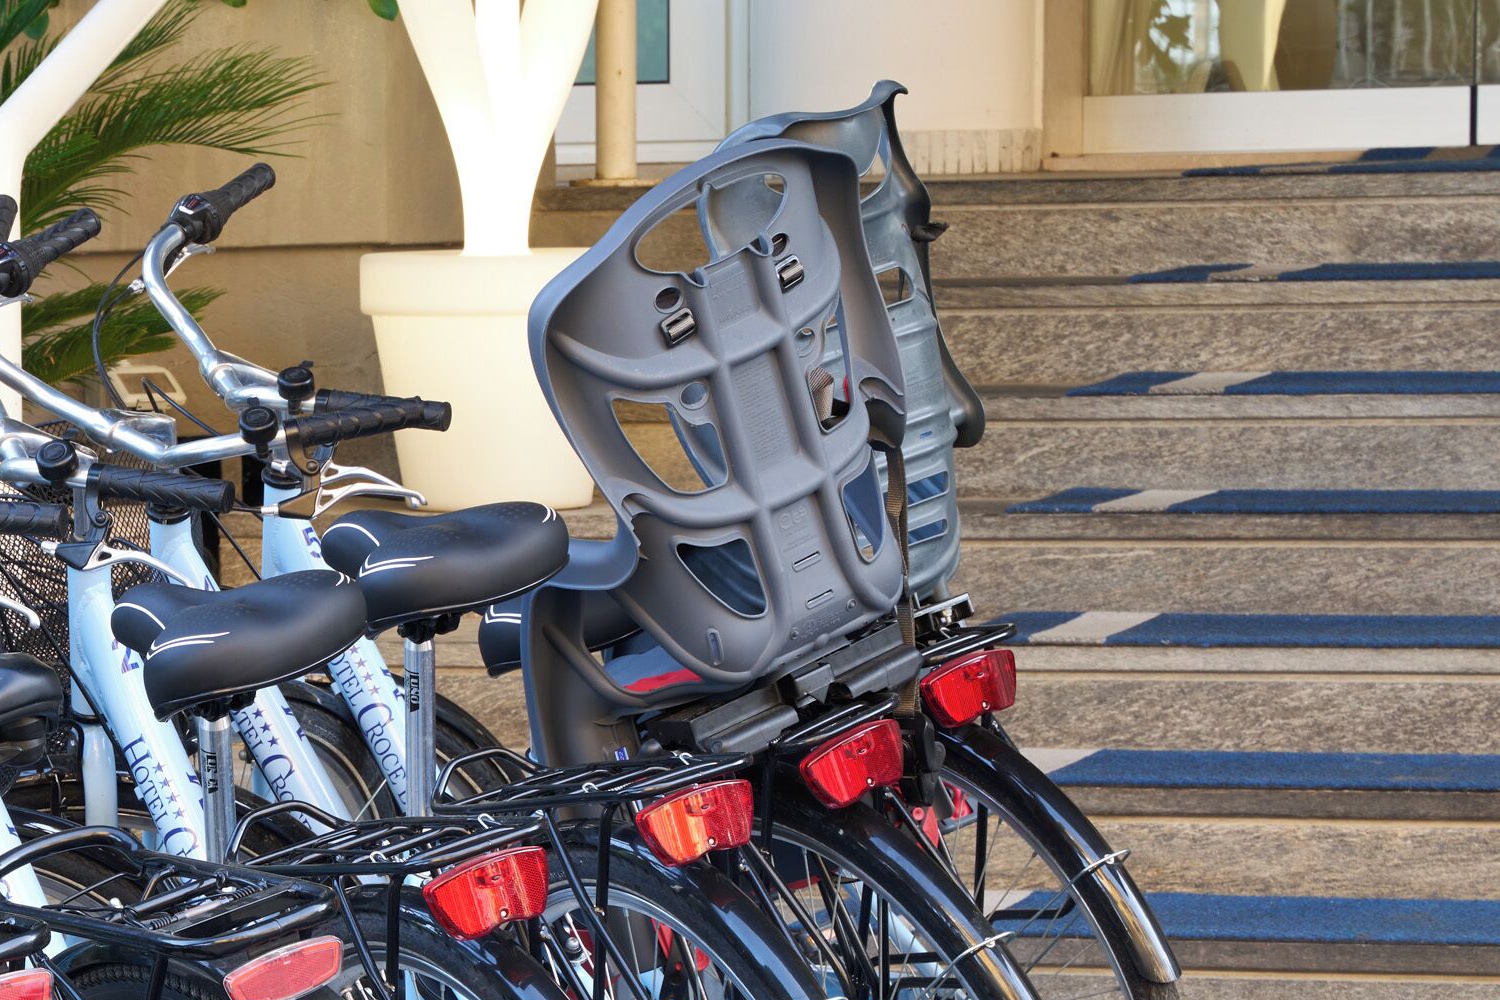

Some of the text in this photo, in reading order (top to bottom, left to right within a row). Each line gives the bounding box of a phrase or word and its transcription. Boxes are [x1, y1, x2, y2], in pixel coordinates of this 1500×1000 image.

[330, 652, 407, 786] OTEL CROCE
[124, 734, 169, 830] HOTEL
